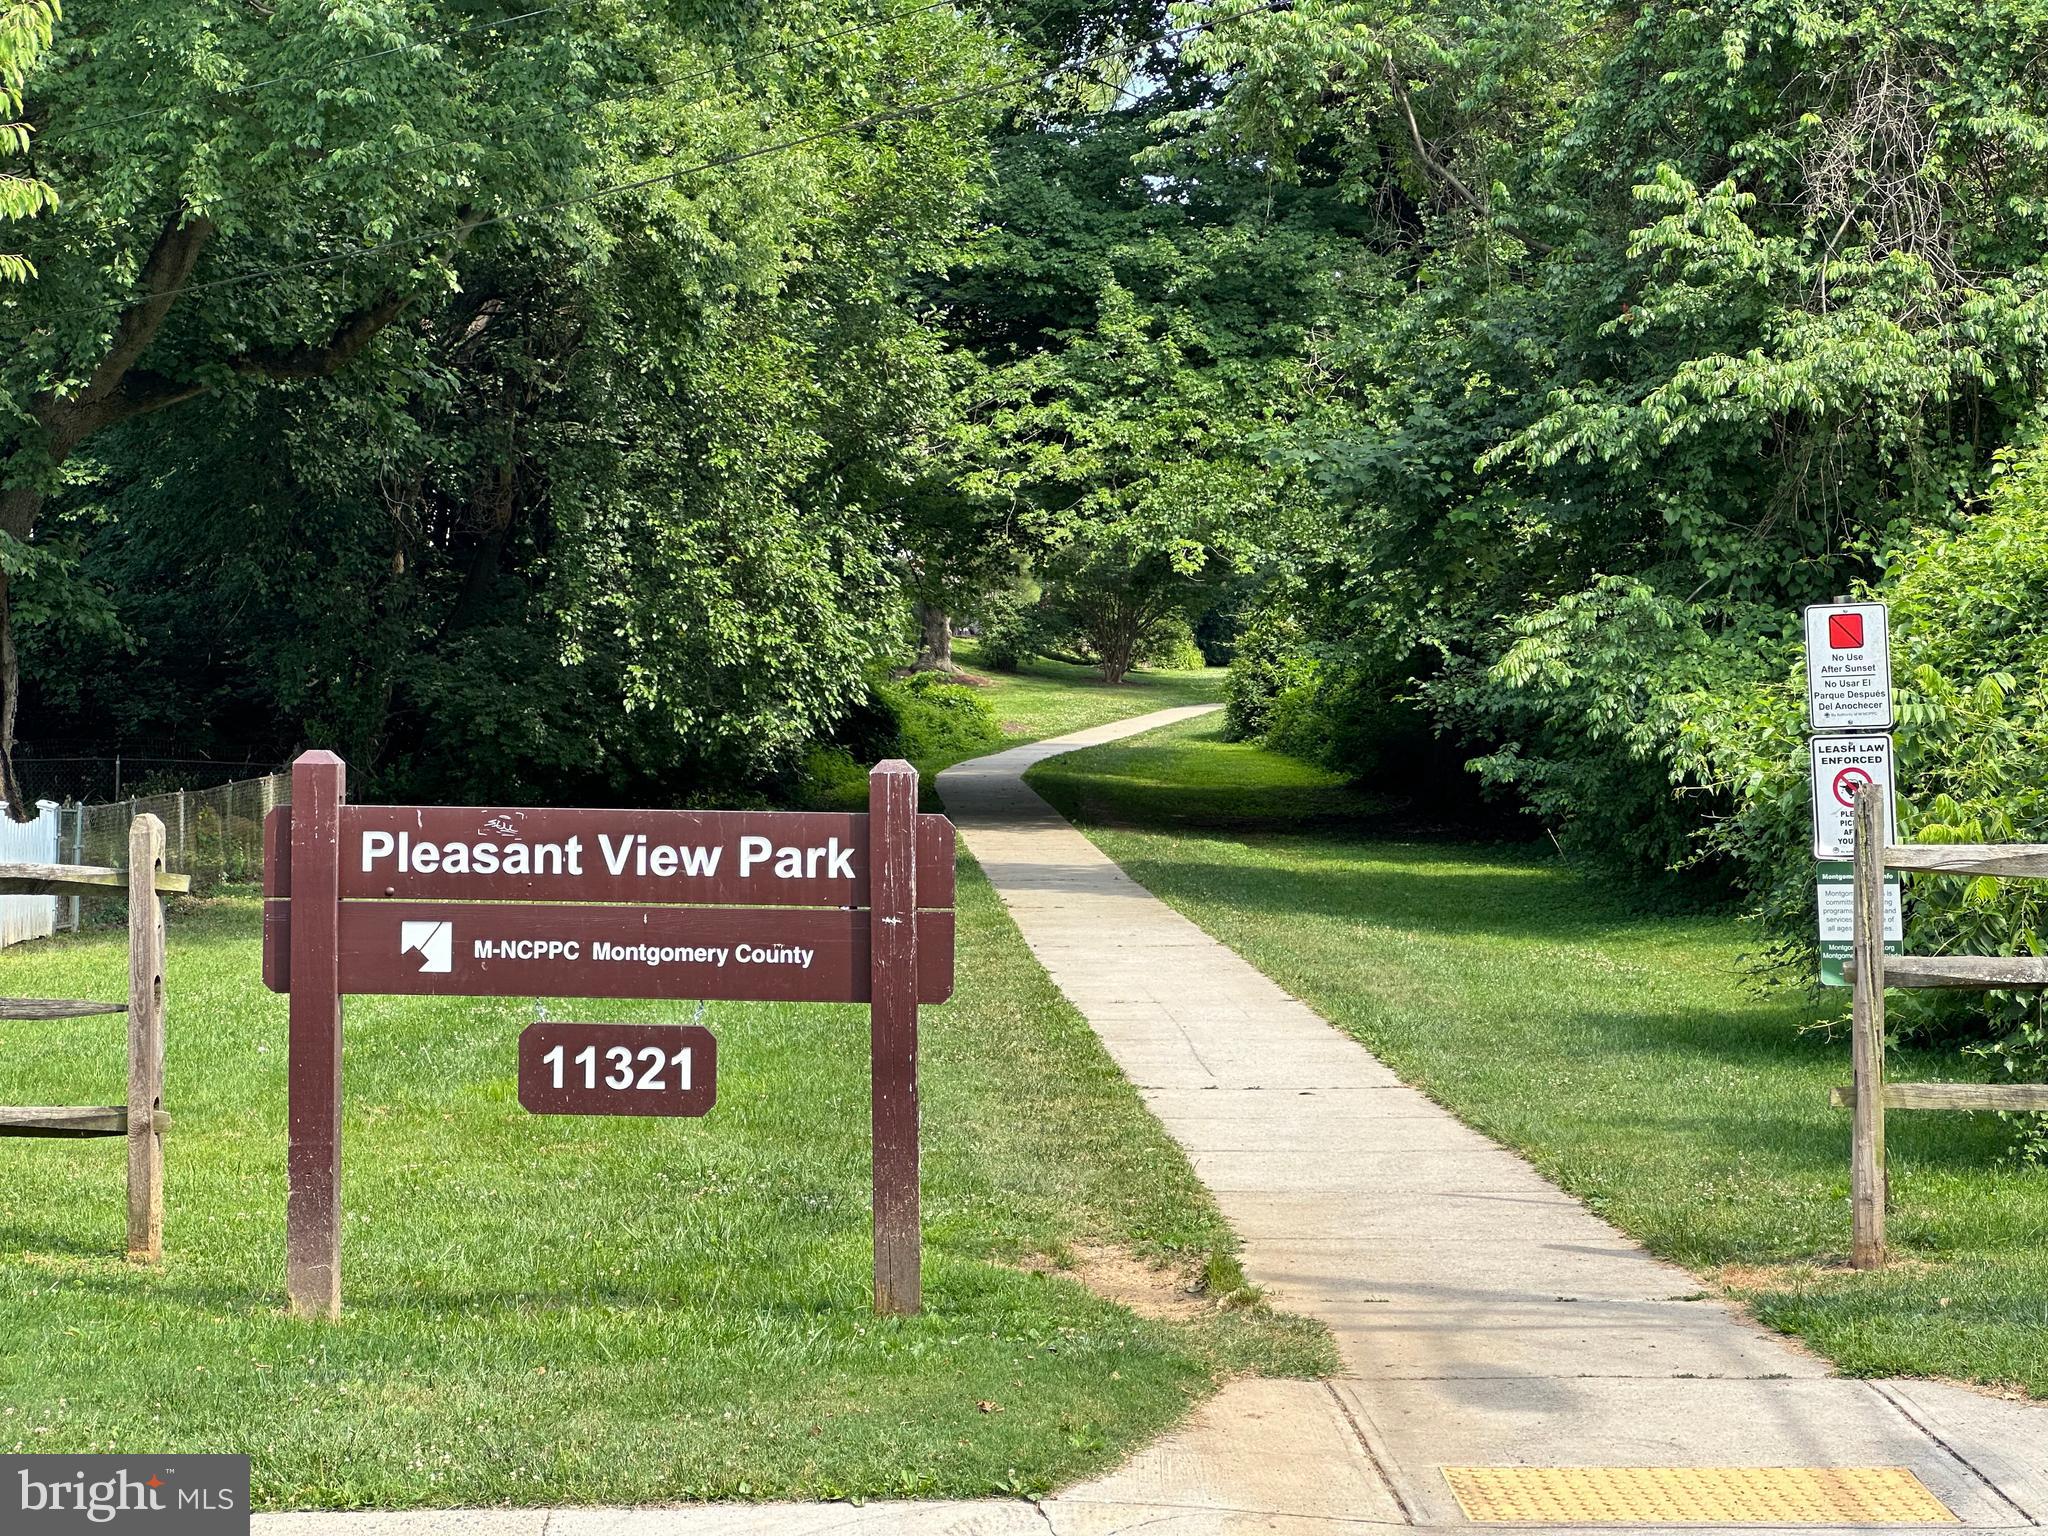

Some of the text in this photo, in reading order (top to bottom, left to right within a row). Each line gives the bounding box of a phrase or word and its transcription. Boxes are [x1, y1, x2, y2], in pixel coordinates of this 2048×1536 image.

[1846, 653, 1864, 661] Use
[1821, 664, 1876, 673] After Sunset
[1839, 679, 1860, 687] Usar
[1814, 690, 1886, 700] Parque Después
[1835, 701, 1883, 710] Anochecer
[1818, 744, 1885, 753] LEASH LAW
[1821, 756, 1882, 764] ENFORCED
[361, 831, 856, 880] Pleasant View Park
[473, 940, 814, 968] M-NCPPC Montgomery County
[543, 1045, 692, 1090] 11321
